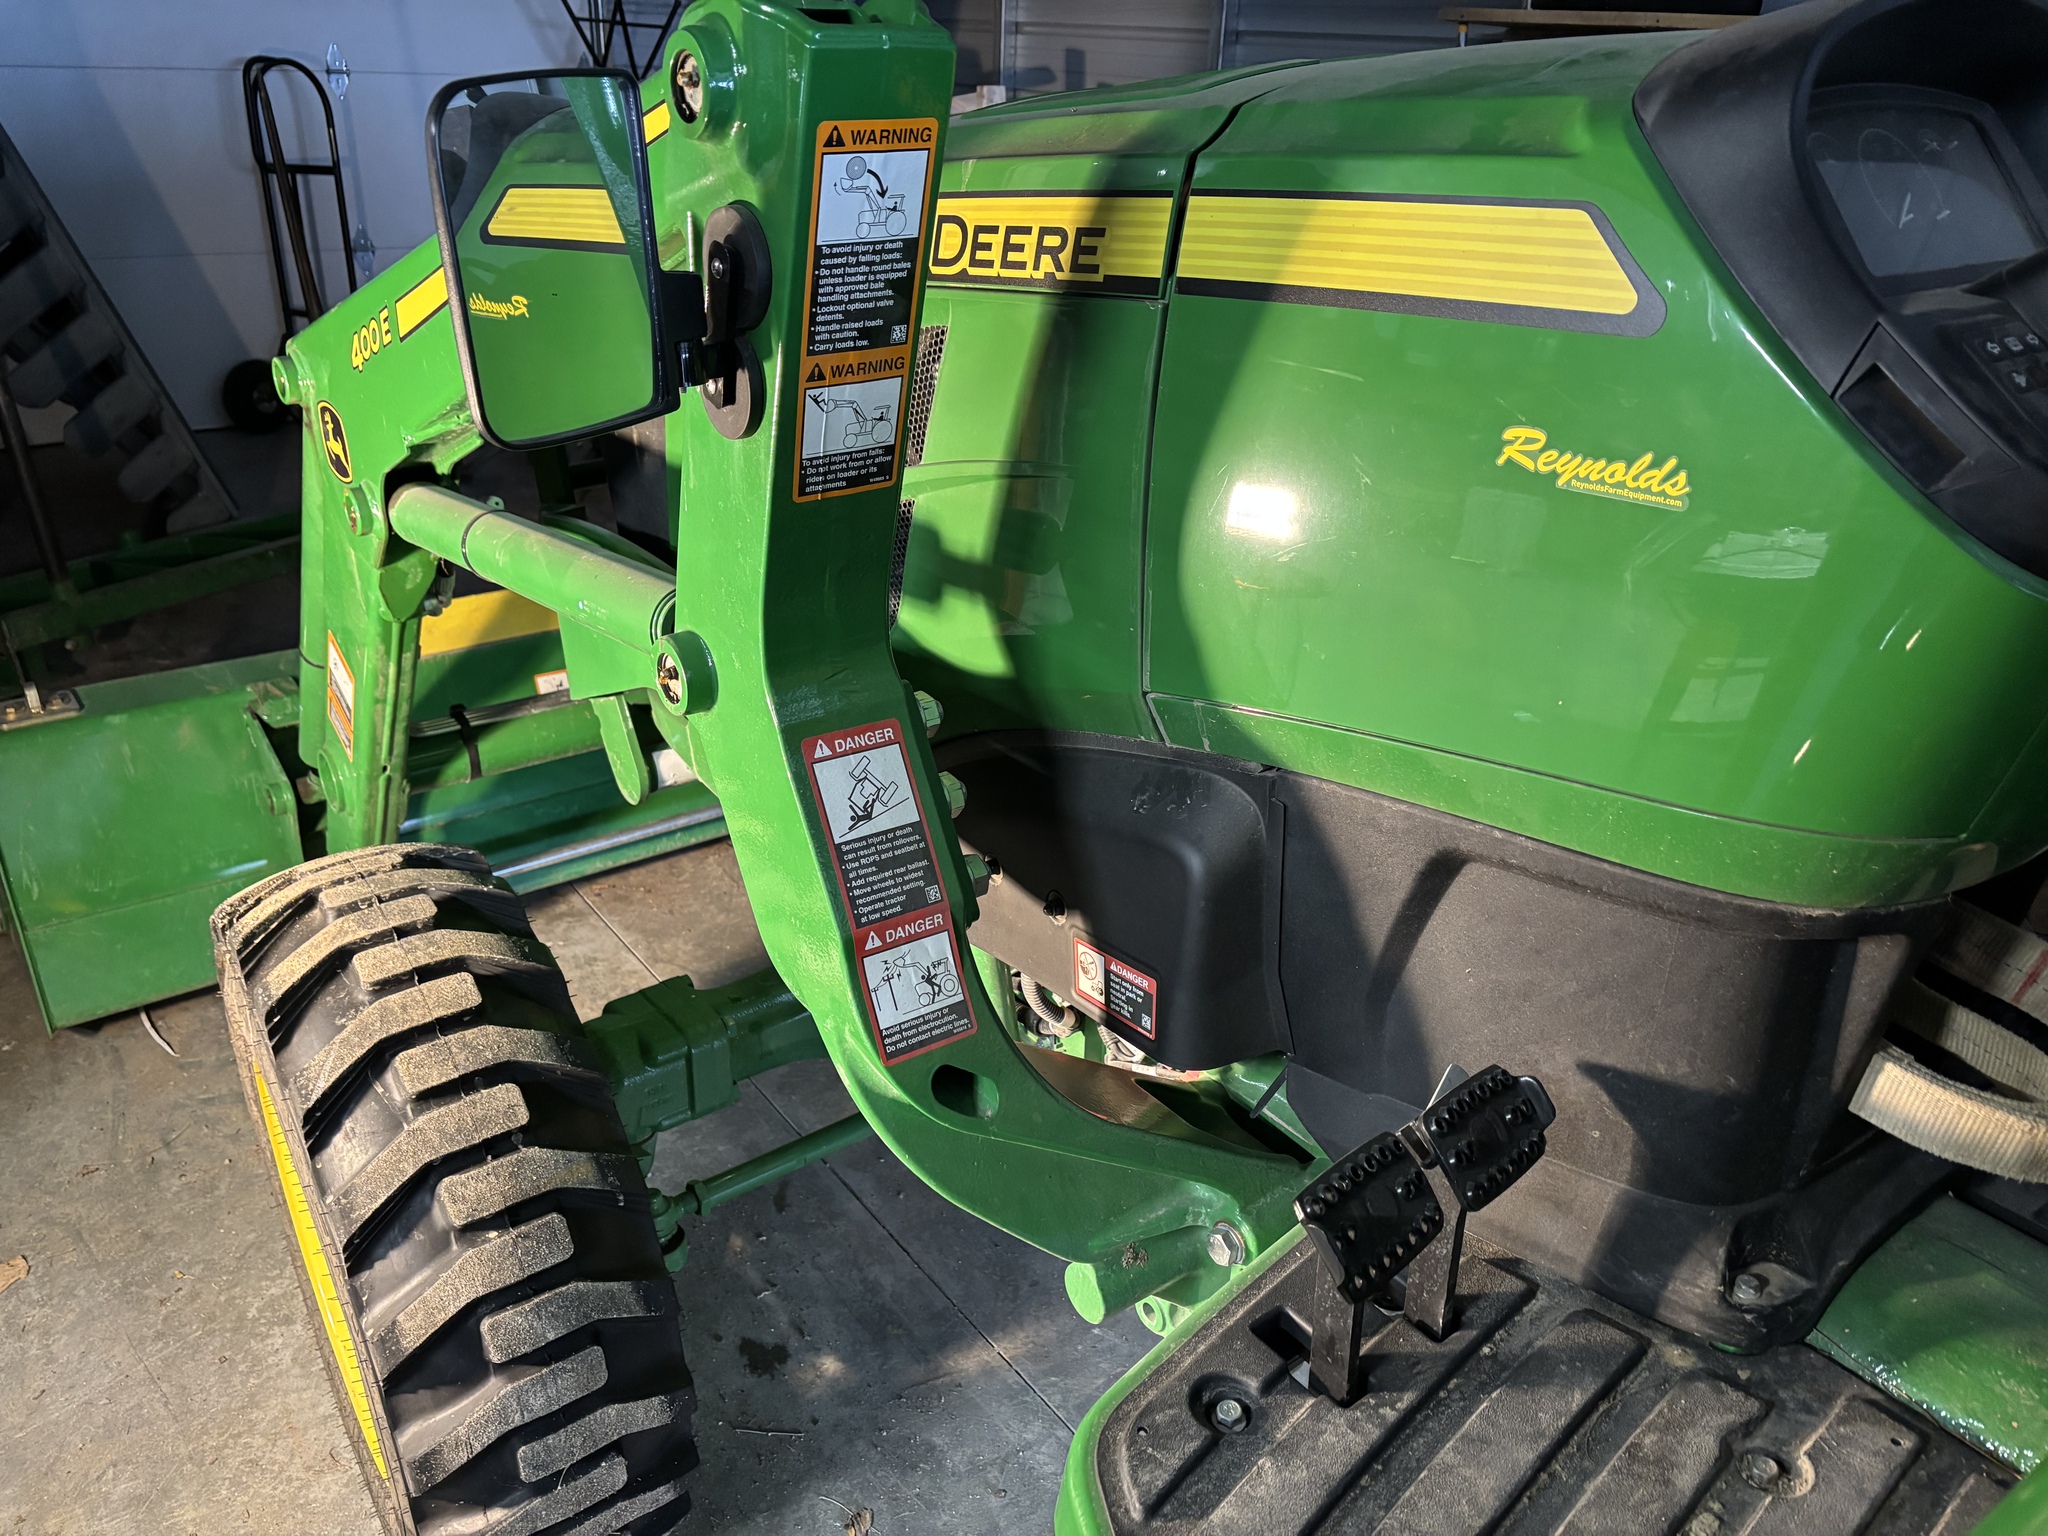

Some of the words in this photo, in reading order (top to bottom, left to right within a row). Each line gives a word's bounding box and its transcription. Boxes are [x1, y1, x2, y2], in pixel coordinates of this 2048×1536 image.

[851, 127, 932, 145] WARNING
[832, 245, 851, 253] avoid
[854, 244, 873, 252] injury
[884, 241, 903, 249] death
[932, 215, 1106, 274] DEERE
[821, 256, 846, 265] caused
[845, 265, 869, 274] handle
[871, 263, 891, 271] round
[819, 276, 842, 284] unless
[845, 274, 867, 283] loader
[876, 270, 907, 280] equipped
[818, 285, 833, 293] with
[835, 283, 868, 293] approved
[818, 293, 848, 302] handling
[850, 289, 894, 299] attachments.
[817, 304, 845, 313] Lockout
[847, 301, 875, 311] optional
[816, 314, 844, 322] detents.
[816, 324, 840, 332] Handle
[832, 330, 859, 339] caution.
[835, 341, 854, 349] loads
[830, 357, 905, 378] WARNING
[812, 457, 829, 465] avoid
[1496, 427, 1690, 496] Reynolds
[837, 469, 858, 478] loader
[1571, 479, 1682, 507] ReynoldsFarmEquipment.com
[835, 727, 894, 753] DANGER
[841, 839, 867, 851] Serious
[868, 835, 886, 844] injury
[896, 826, 912, 836] death
[858, 848, 876, 857] result
[878, 843, 892, 852] from
[893, 836, 921, 847] rollovers.
[846, 860, 859, 870] Use
[861, 855, 879, 866] ROPS
[881, 851, 893, 859] and
[894, 844, 918, 856] seatbelt
[849, 870, 857, 878] all
[858, 866, 878, 876] times.
[852, 878, 864, 887] Add
[867, 869, 893, 883] required
[894, 866, 906, 874] rear
[908, 859, 930, 870] ballast.
[853, 887, 871, 896] Move
[873, 878, 895, 890] wheels
[904, 870, 924, 881] widest
[856, 887, 902, 905] recommended
[903, 880, 925, 890] setting.
[859, 901, 884, 914] Operate
[885, 894, 906, 904] tractor
[882, 906, 903, 916] speed.
[886, 913, 944, 943] DANGER
[1117, 966, 1148, 989] DANGER
[1122, 980, 1132, 990] only
[1133, 986, 1144, 996] from
[1126, 991, 1136, 1000] park
[882, 1026, 900, 1036] Avoid
[901, 1017, 923, 1029] serious
[924, 1011, 941, 1020] injury
[884, 1034, 902, 1044] death
[903, 1029, 917, 1038] from
[918, 1013, 958, 1032] electrocution.
[897, 1040, 907, 1049] not
[908, 1033, 931, 1045] contact
[932, 1024, 953, 1036] electric
[954, 1018, 969, 1027] lines.
